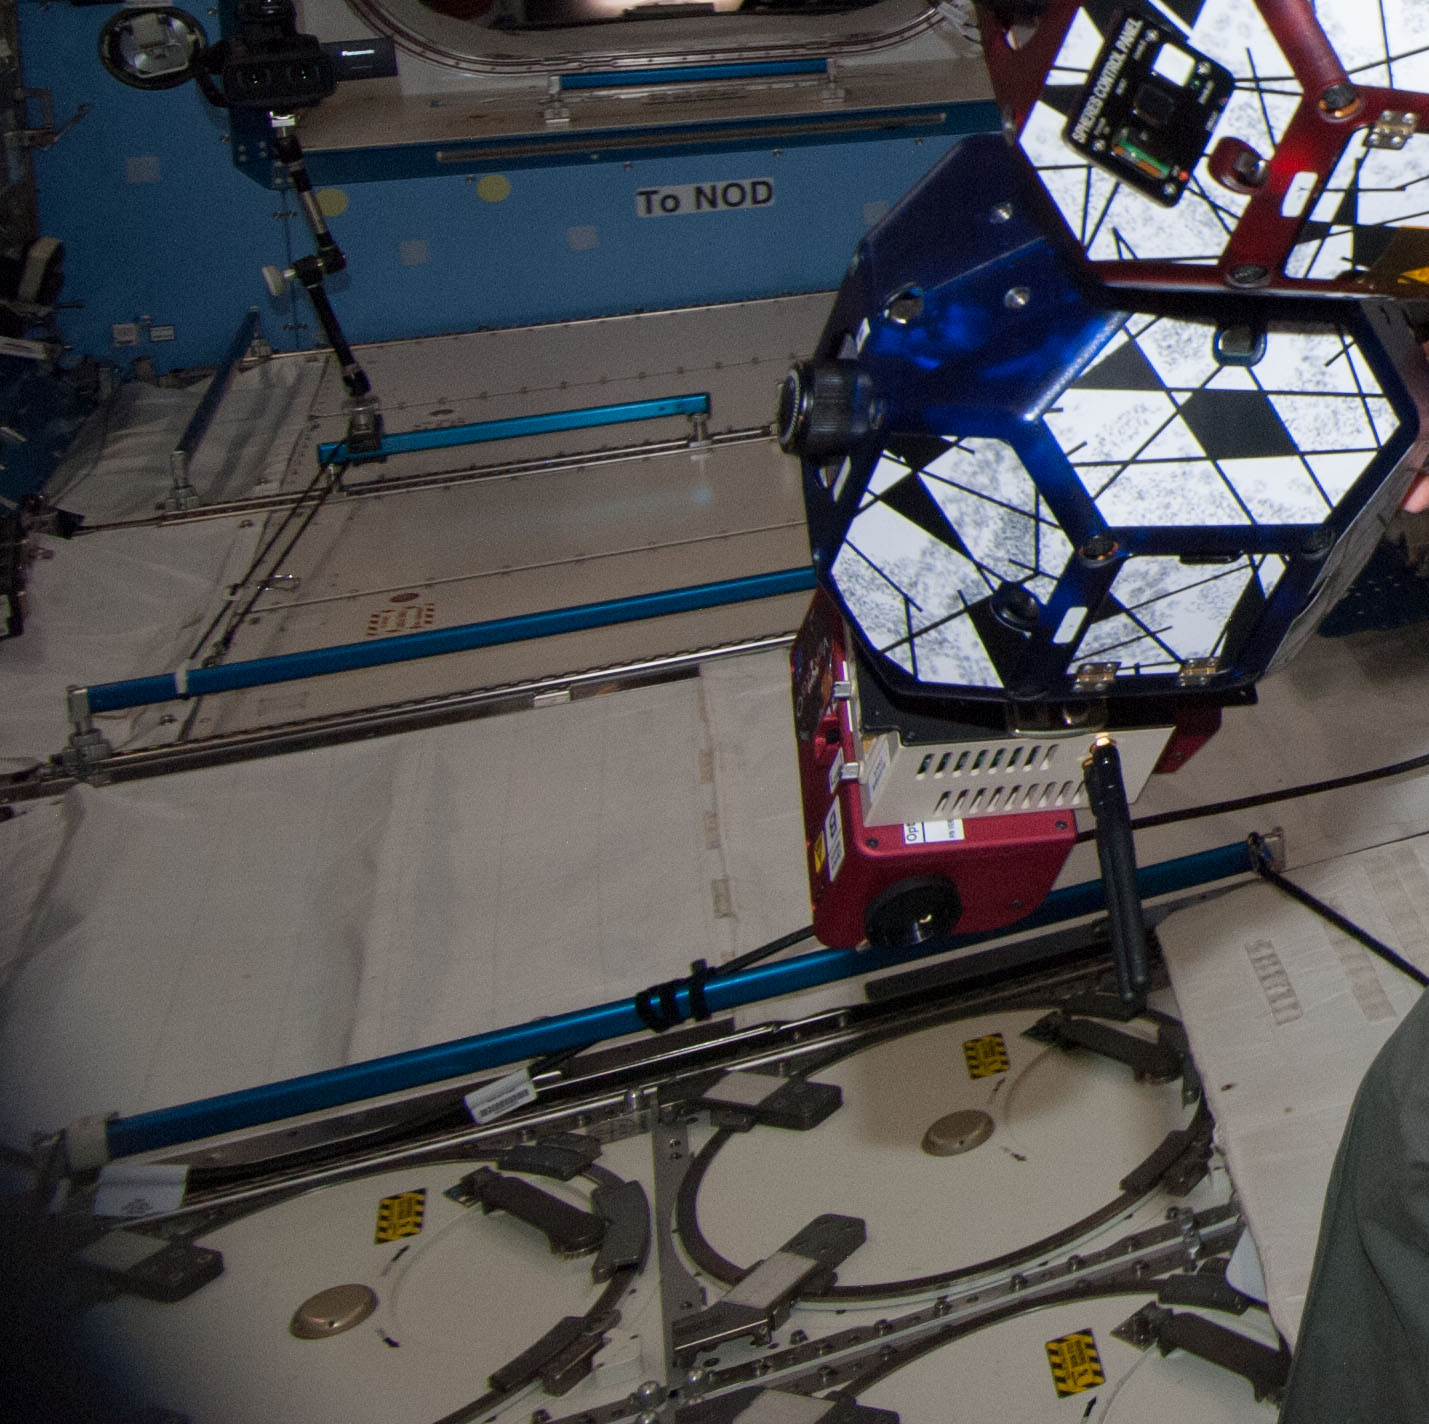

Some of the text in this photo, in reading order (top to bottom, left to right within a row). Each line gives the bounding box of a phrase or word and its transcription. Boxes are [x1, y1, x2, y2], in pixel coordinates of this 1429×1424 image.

[1071, 94, 1104, 145] SPHERES
[1093, 50, 1128, 99] CONTROL
[1115, 17, 1144, 54] PANEL
[636, 180, 773, 214] To NOD
